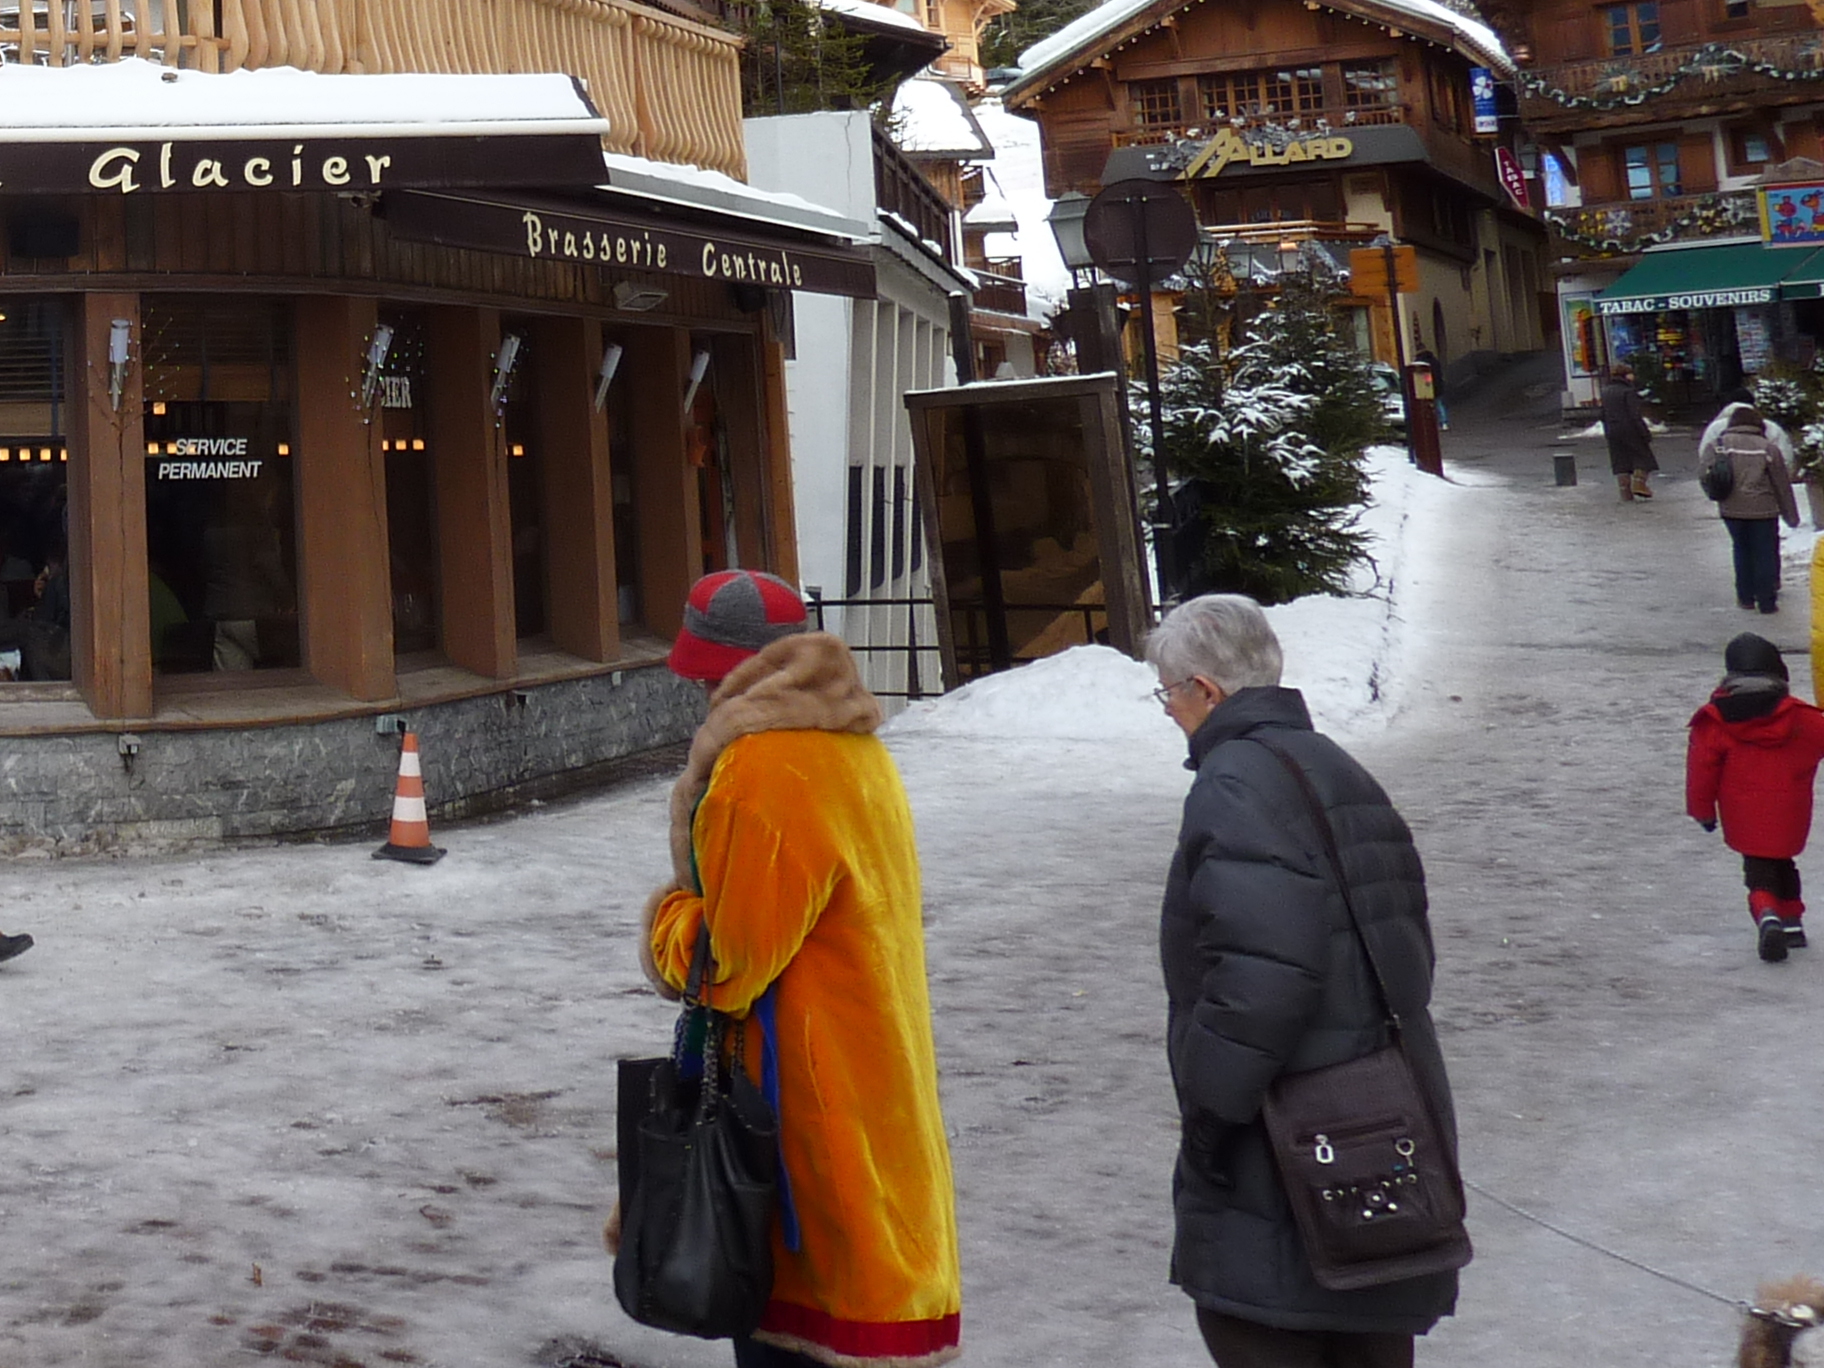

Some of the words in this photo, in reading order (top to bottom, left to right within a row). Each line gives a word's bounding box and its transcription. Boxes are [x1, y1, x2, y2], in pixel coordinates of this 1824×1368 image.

[88, 142, 391, 194] Glacier
[1502, 160, 1524, 196] TABAC
[523, 211, 667, 268] Brasserie
[702, 242, 802, 287] Centrale
[1600, 298, 1656, 315] TABAC
[1668, 288, 1772, 311] SOUVENIRS
[176, 438, 248, 456] SERVICE
[158, 461, 262, 480] PERMANENT
